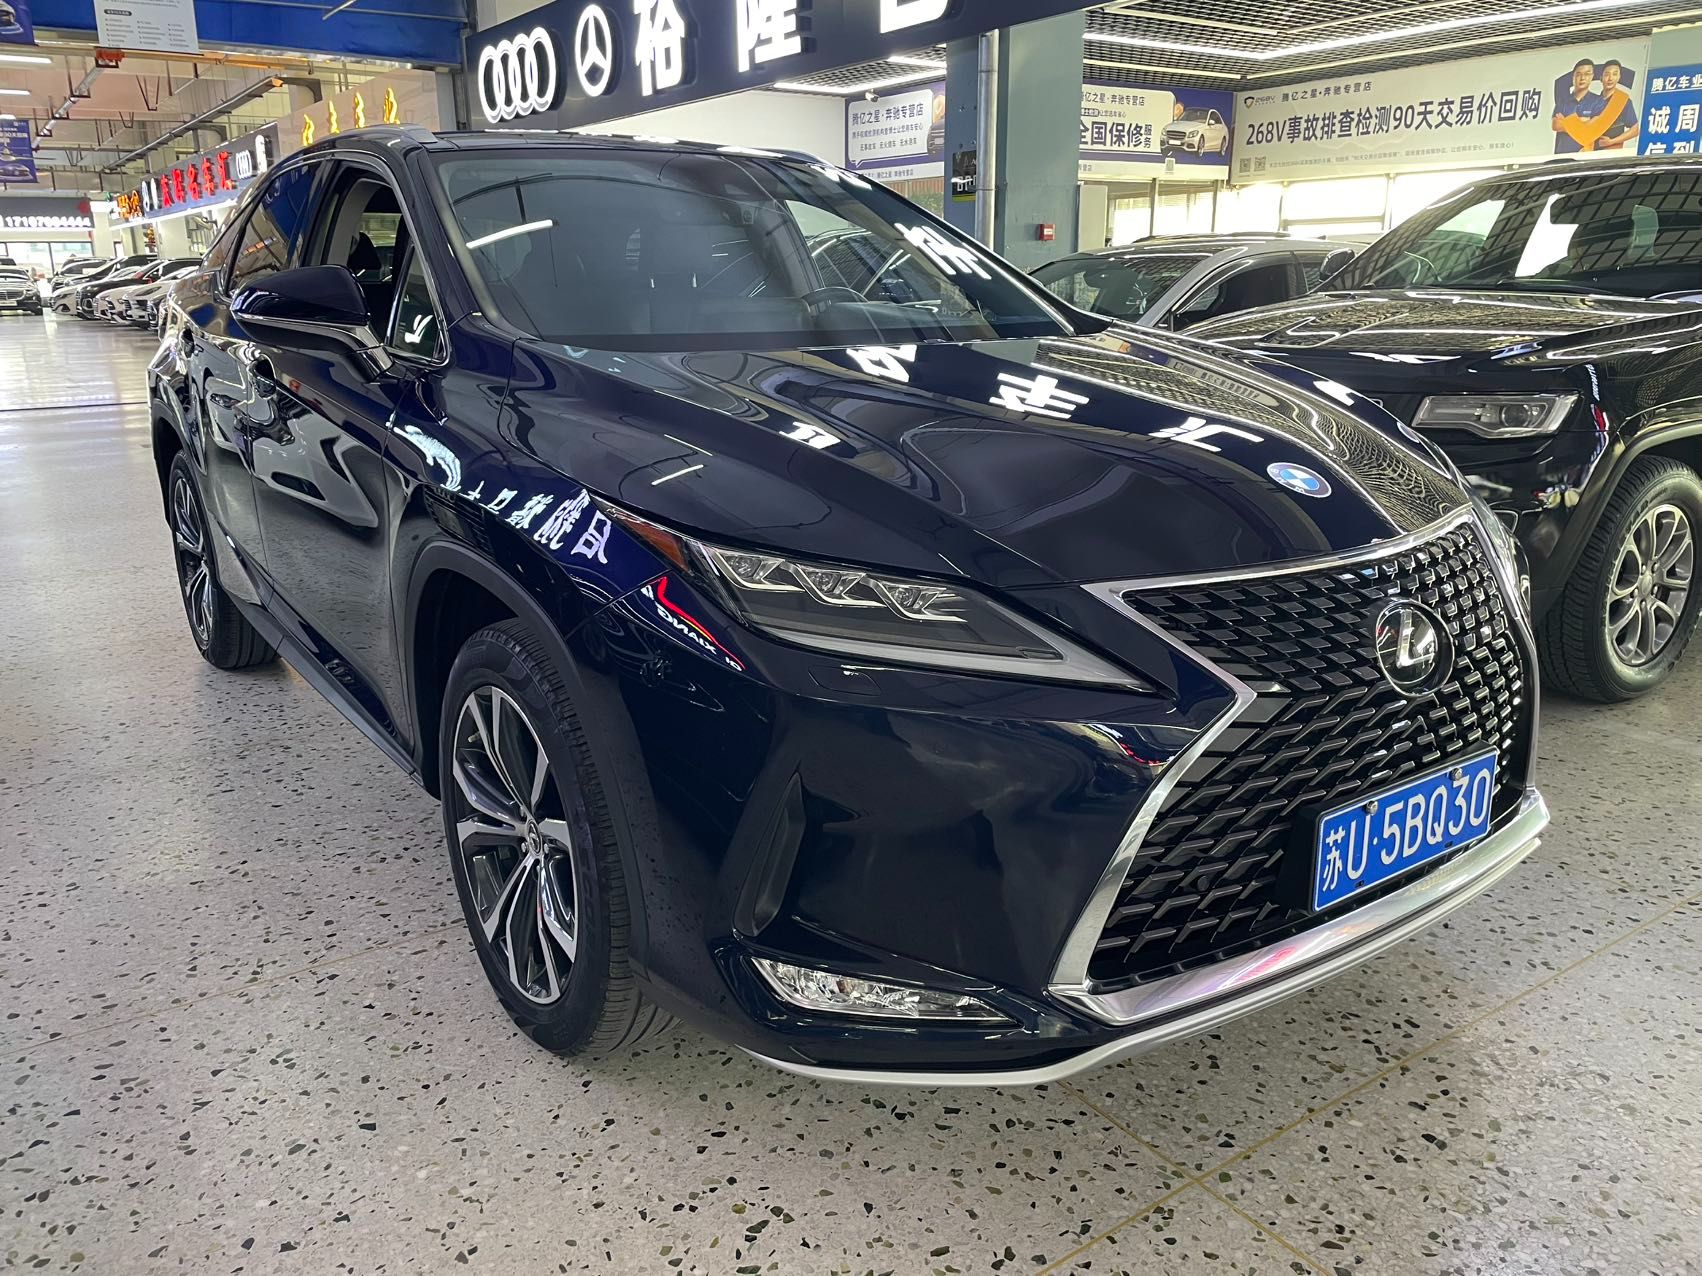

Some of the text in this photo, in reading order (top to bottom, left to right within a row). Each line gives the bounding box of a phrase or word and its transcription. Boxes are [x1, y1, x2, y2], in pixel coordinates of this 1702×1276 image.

[1081, 92, 1145, 106] 亿之星·奔驰专营店
[1246, 88, 1542, 145] 268V事故排查检测90天交易价回购
